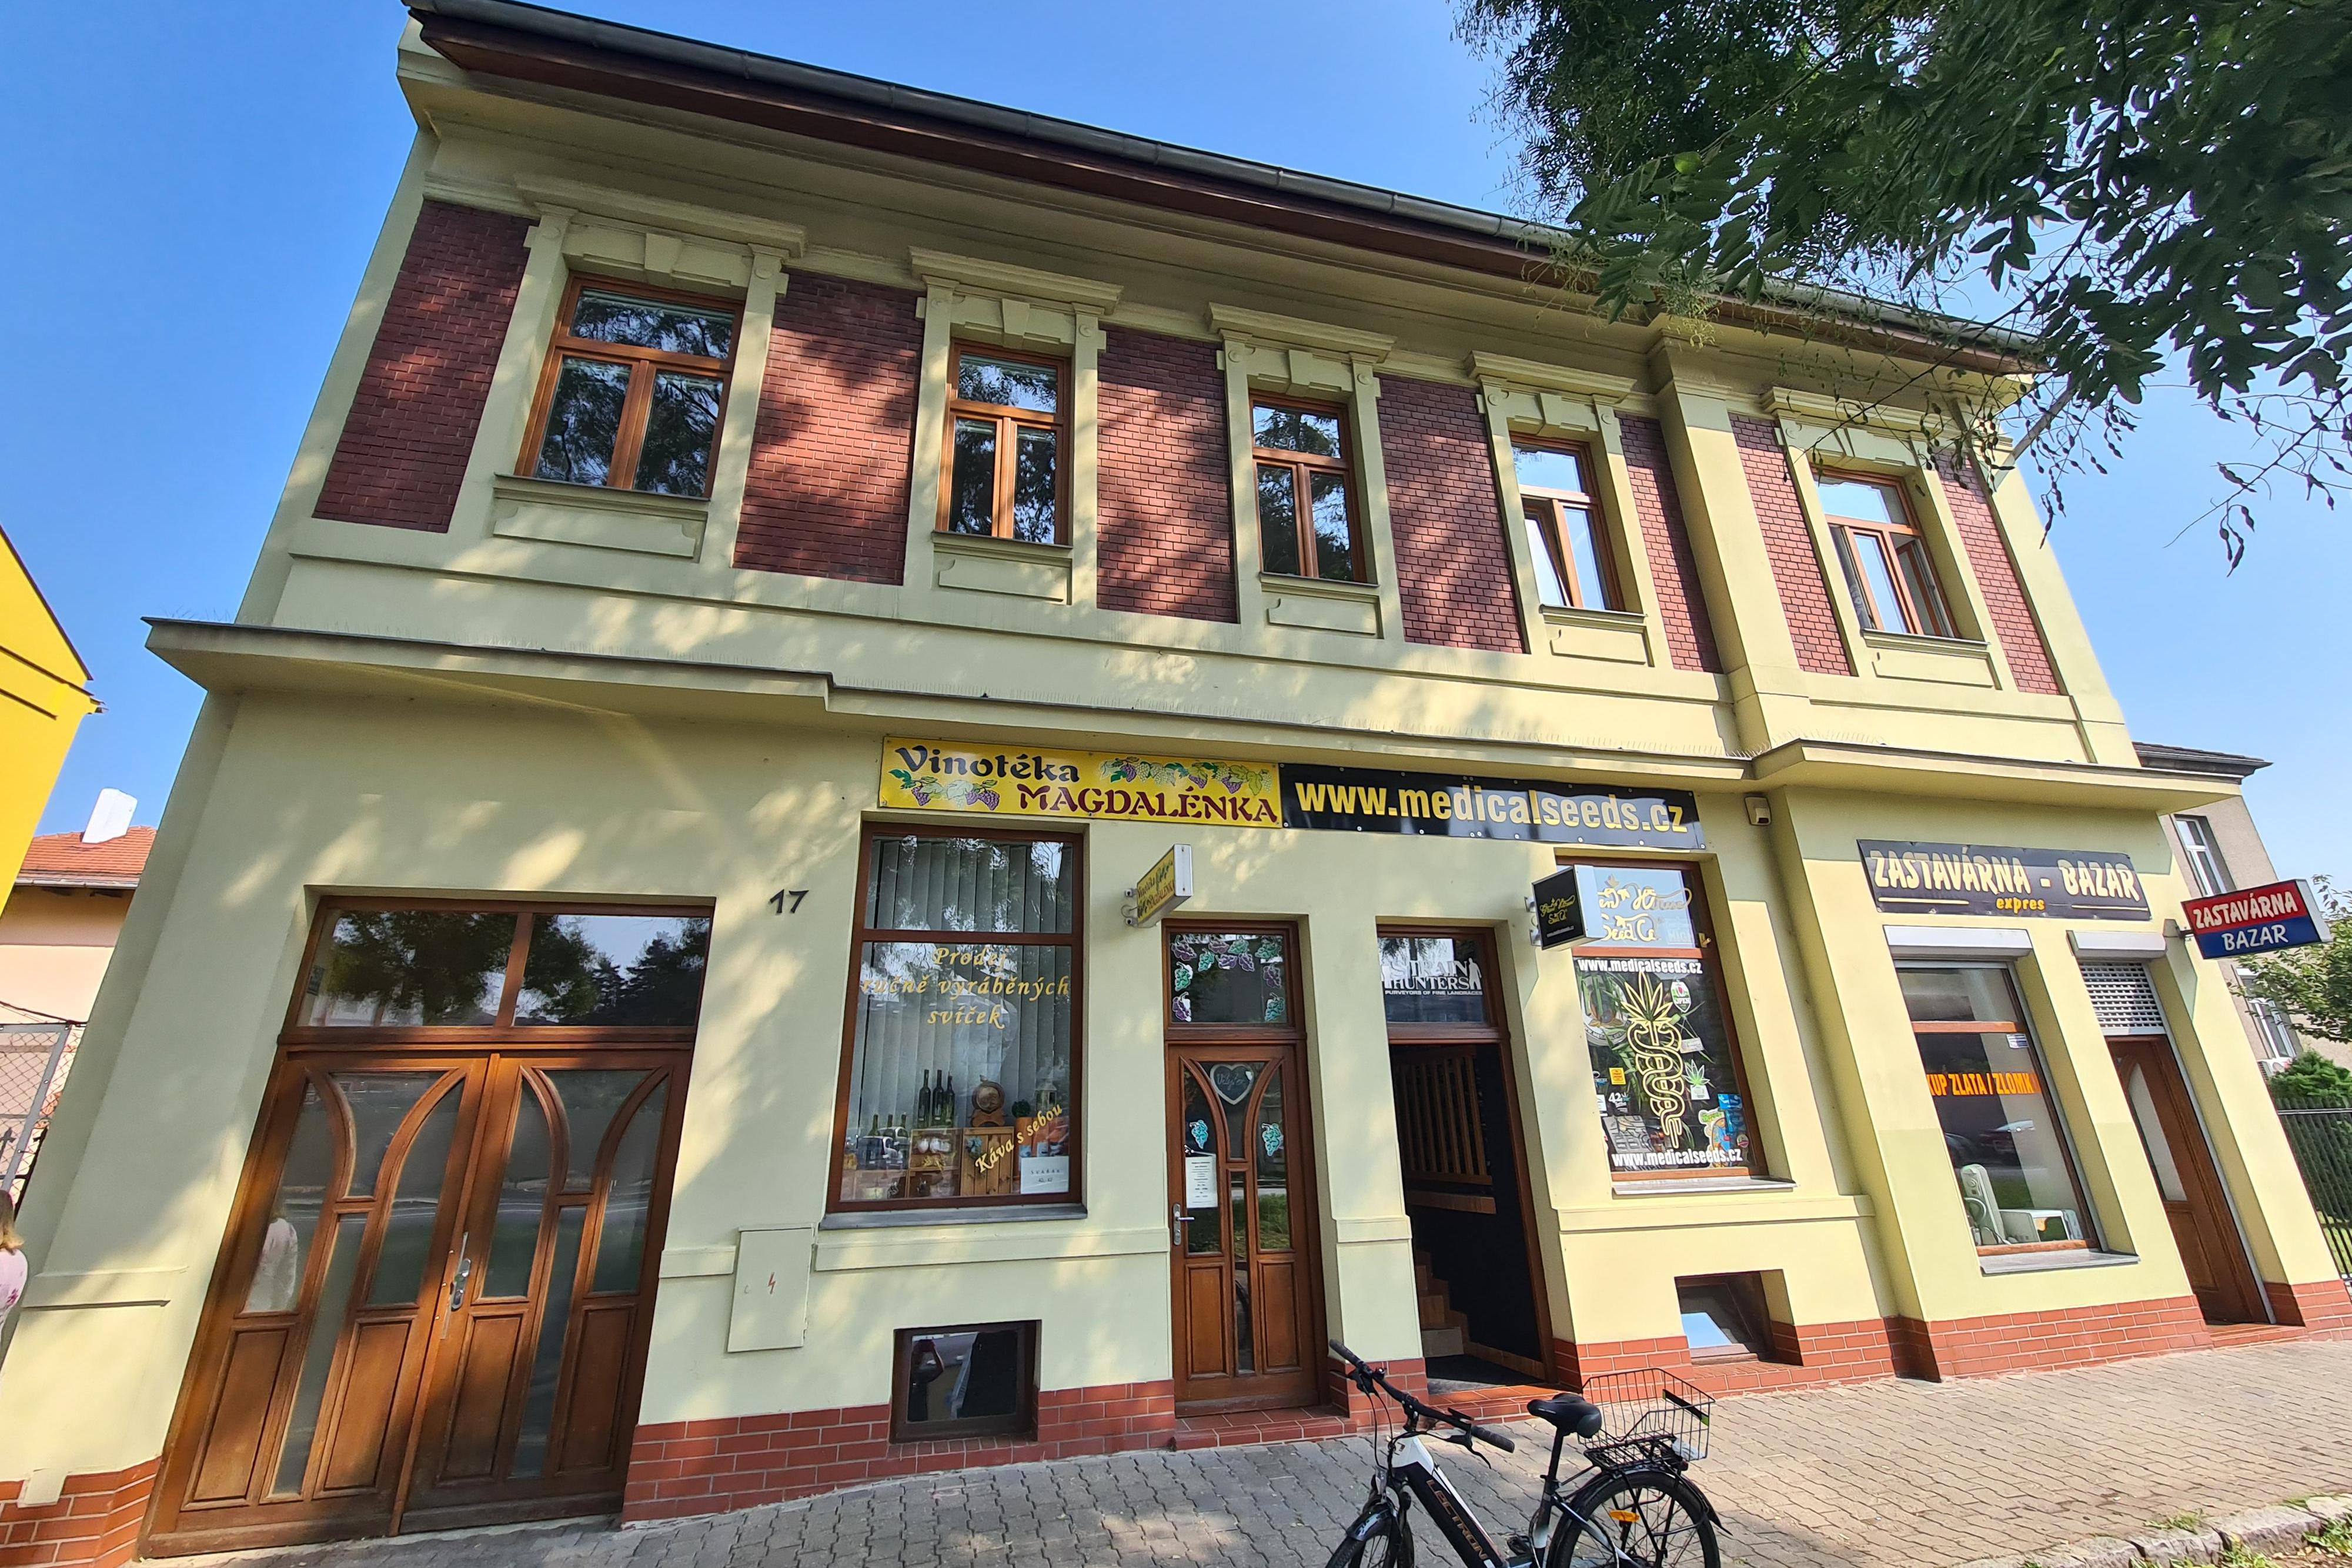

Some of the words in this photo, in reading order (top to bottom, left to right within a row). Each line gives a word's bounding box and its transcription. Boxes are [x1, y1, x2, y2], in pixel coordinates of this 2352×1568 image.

[895, 745, 1080, 783] Vinotéka
[1017, 783, 1278, 823] MAGDALÉNKA
[1295, 782, 1688, 833] www.medicalseeds.cz
[1870, 845, 2032, 895] ZASTAVÁRNA
[2058, 859, 2141, 901] BAZAR
[770, 889, 809, 914] 17
[1996, 897, 2045, 914] expres
[2193, 891, 2298, 929] ZASTAVÁRNA
[2222, 924, 2288, 951] BAZAR
[933, 947, 1007, 972] Prodej
[1577, 959, 1703, 974] www.medicalseeds.cz
[861, 975, 930, 995] ručně
[938, 975, 1070, 1002] vyráběných
[1394, 977, 1470, 990] HUNTERS
[927, 1004, 1004, 1029] svíček
[1948, 1074, 1987, 1095] ZLATA
[975, 1139, 1014, 1173] Káva
[1017, 1132, 1024, 1144] s
[1027, 1104, 1063, 1136] sebou
[1612, 1148, 1743, 1167] www.medicalseeds.cz
